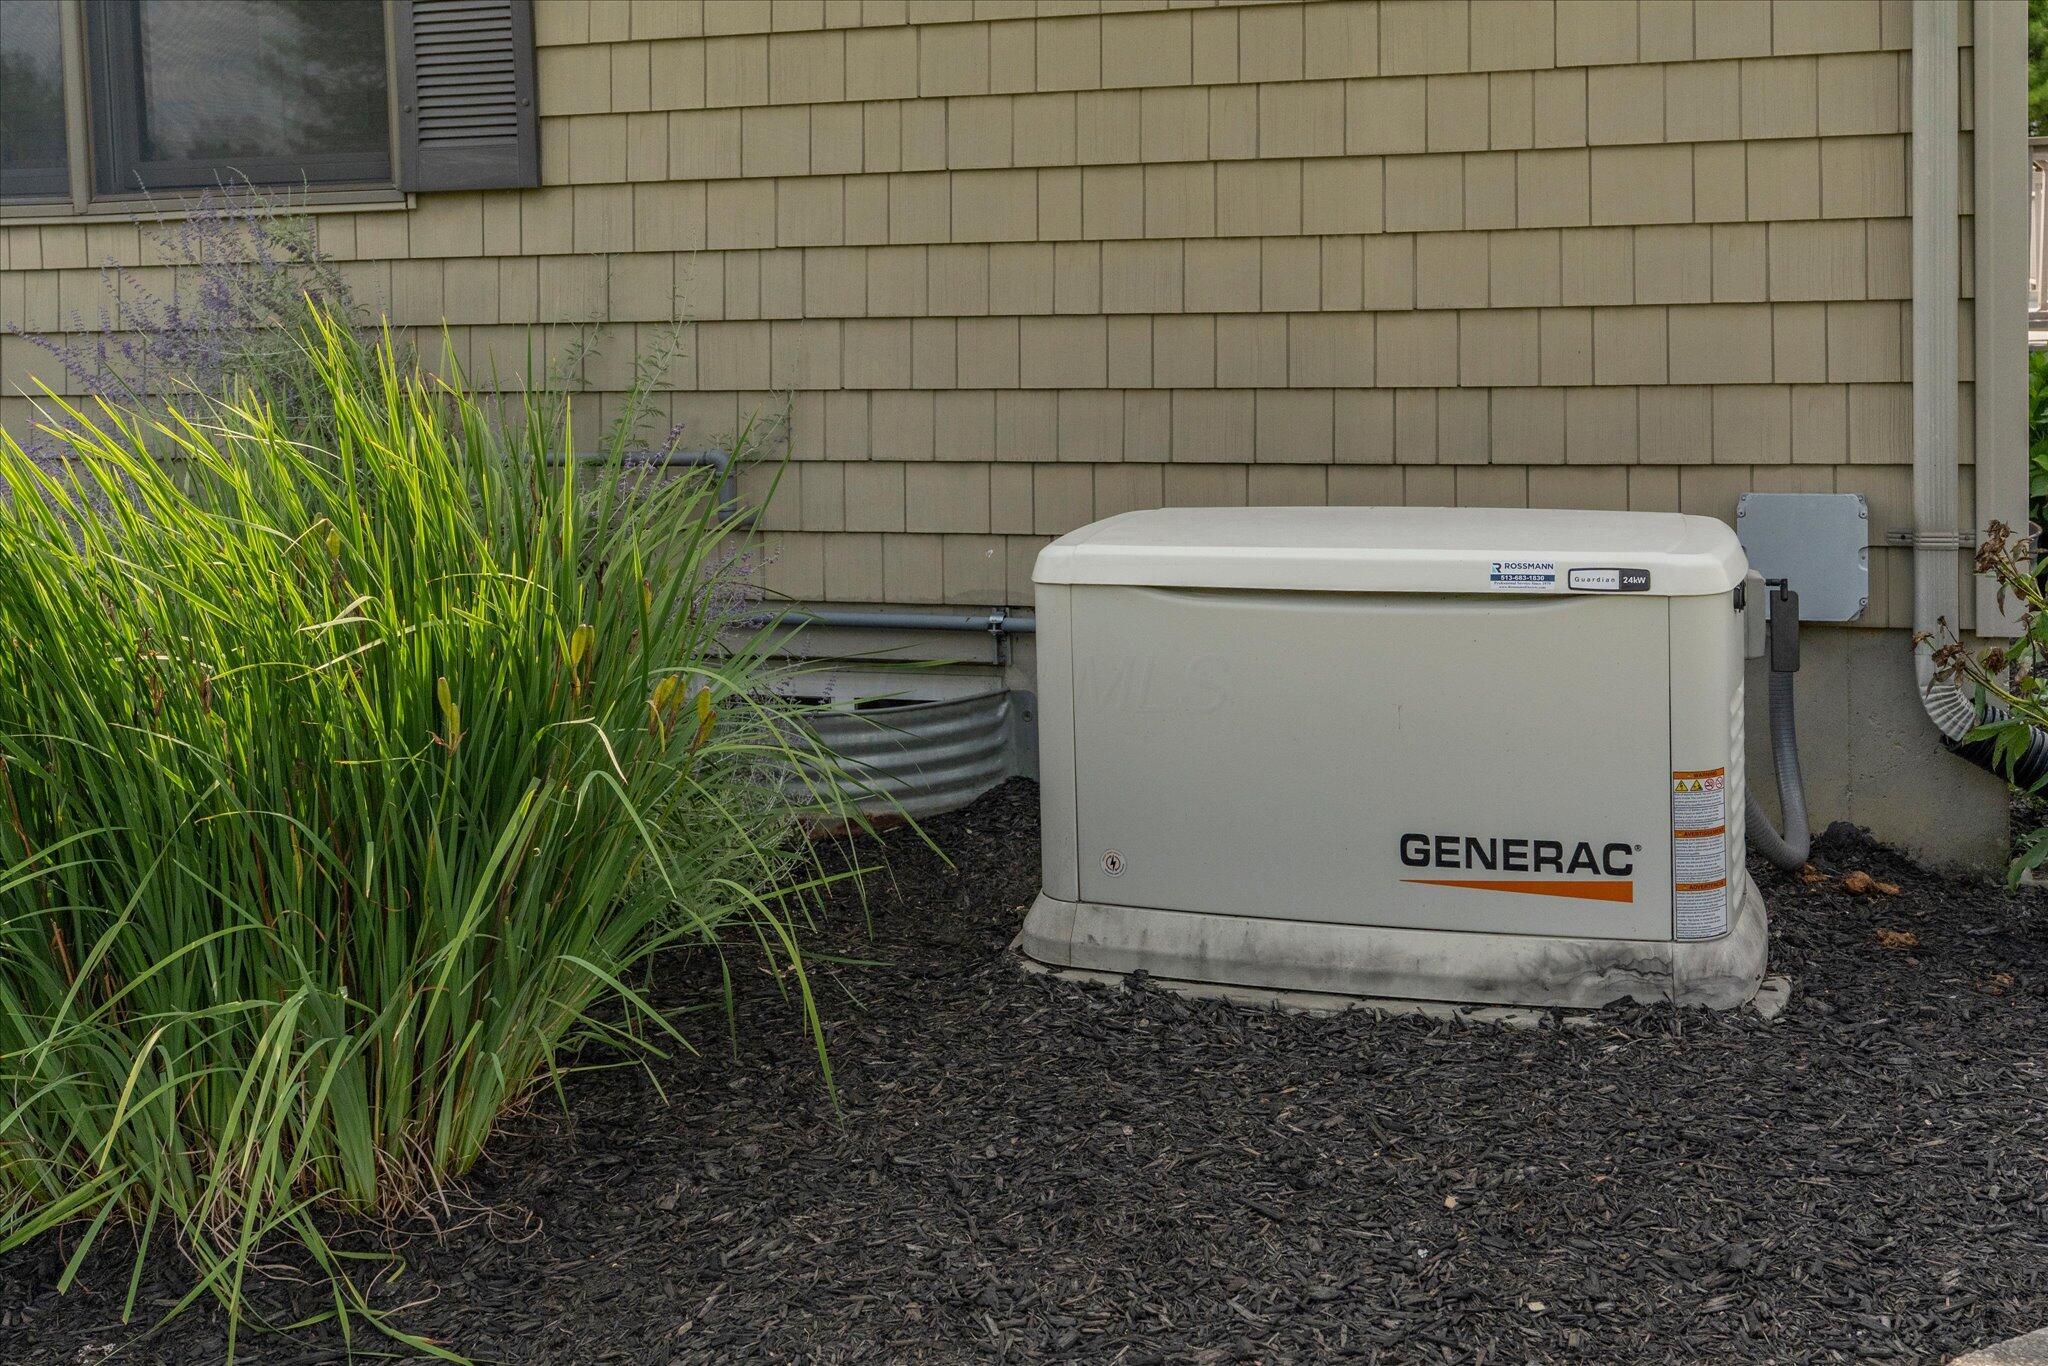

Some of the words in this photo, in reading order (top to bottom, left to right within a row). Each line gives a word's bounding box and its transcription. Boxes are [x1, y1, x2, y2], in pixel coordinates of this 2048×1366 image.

[1504, 562, 1554, 570] ROSSMANN
[1622, 576, 1647, 584] 24kW
[1692, 769, 1718, 778] WARNING
